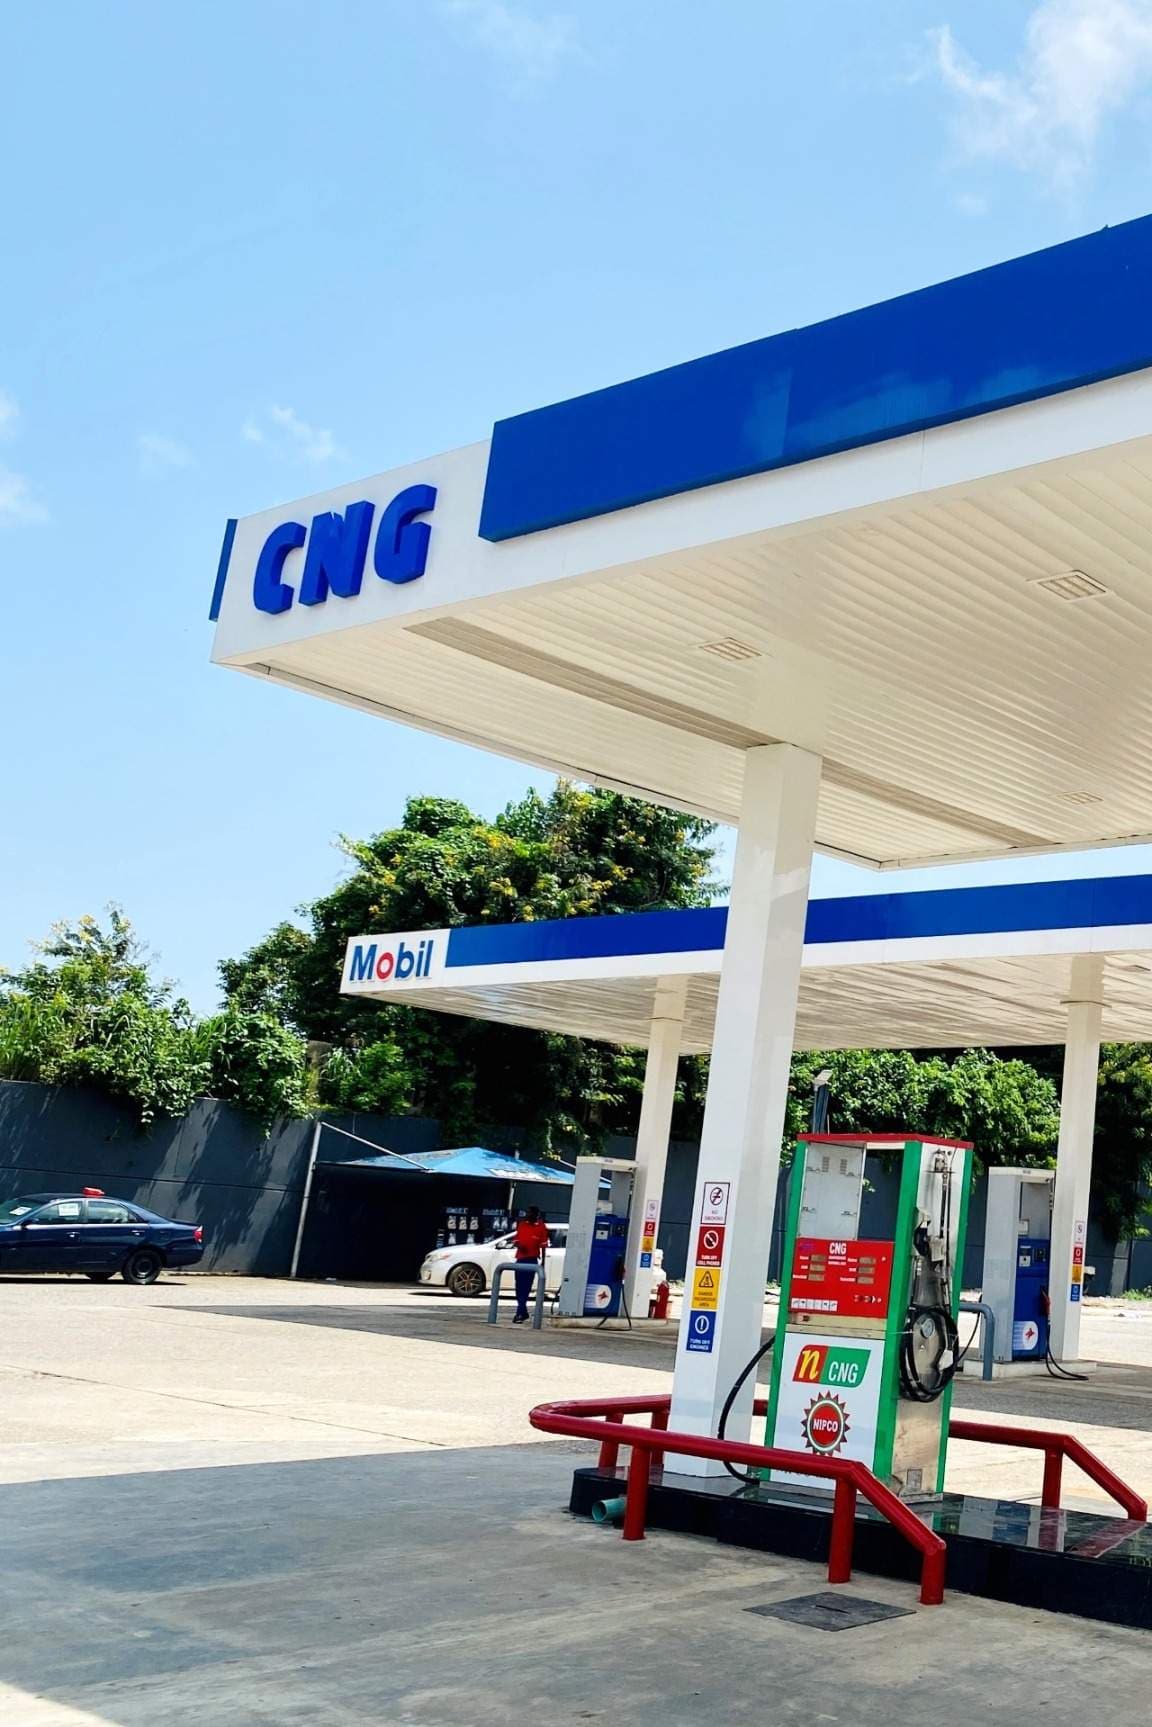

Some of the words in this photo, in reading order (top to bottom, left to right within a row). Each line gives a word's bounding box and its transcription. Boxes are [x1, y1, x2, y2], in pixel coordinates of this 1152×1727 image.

[253, 484, 438, 615] CNG
[350, 940, 434, 980] Mobil
[829, 1242, 847, 1254] CNG
[828, 1361, 858, 1383] CNG
[813, 1418, 838, 1432] NIPCO
